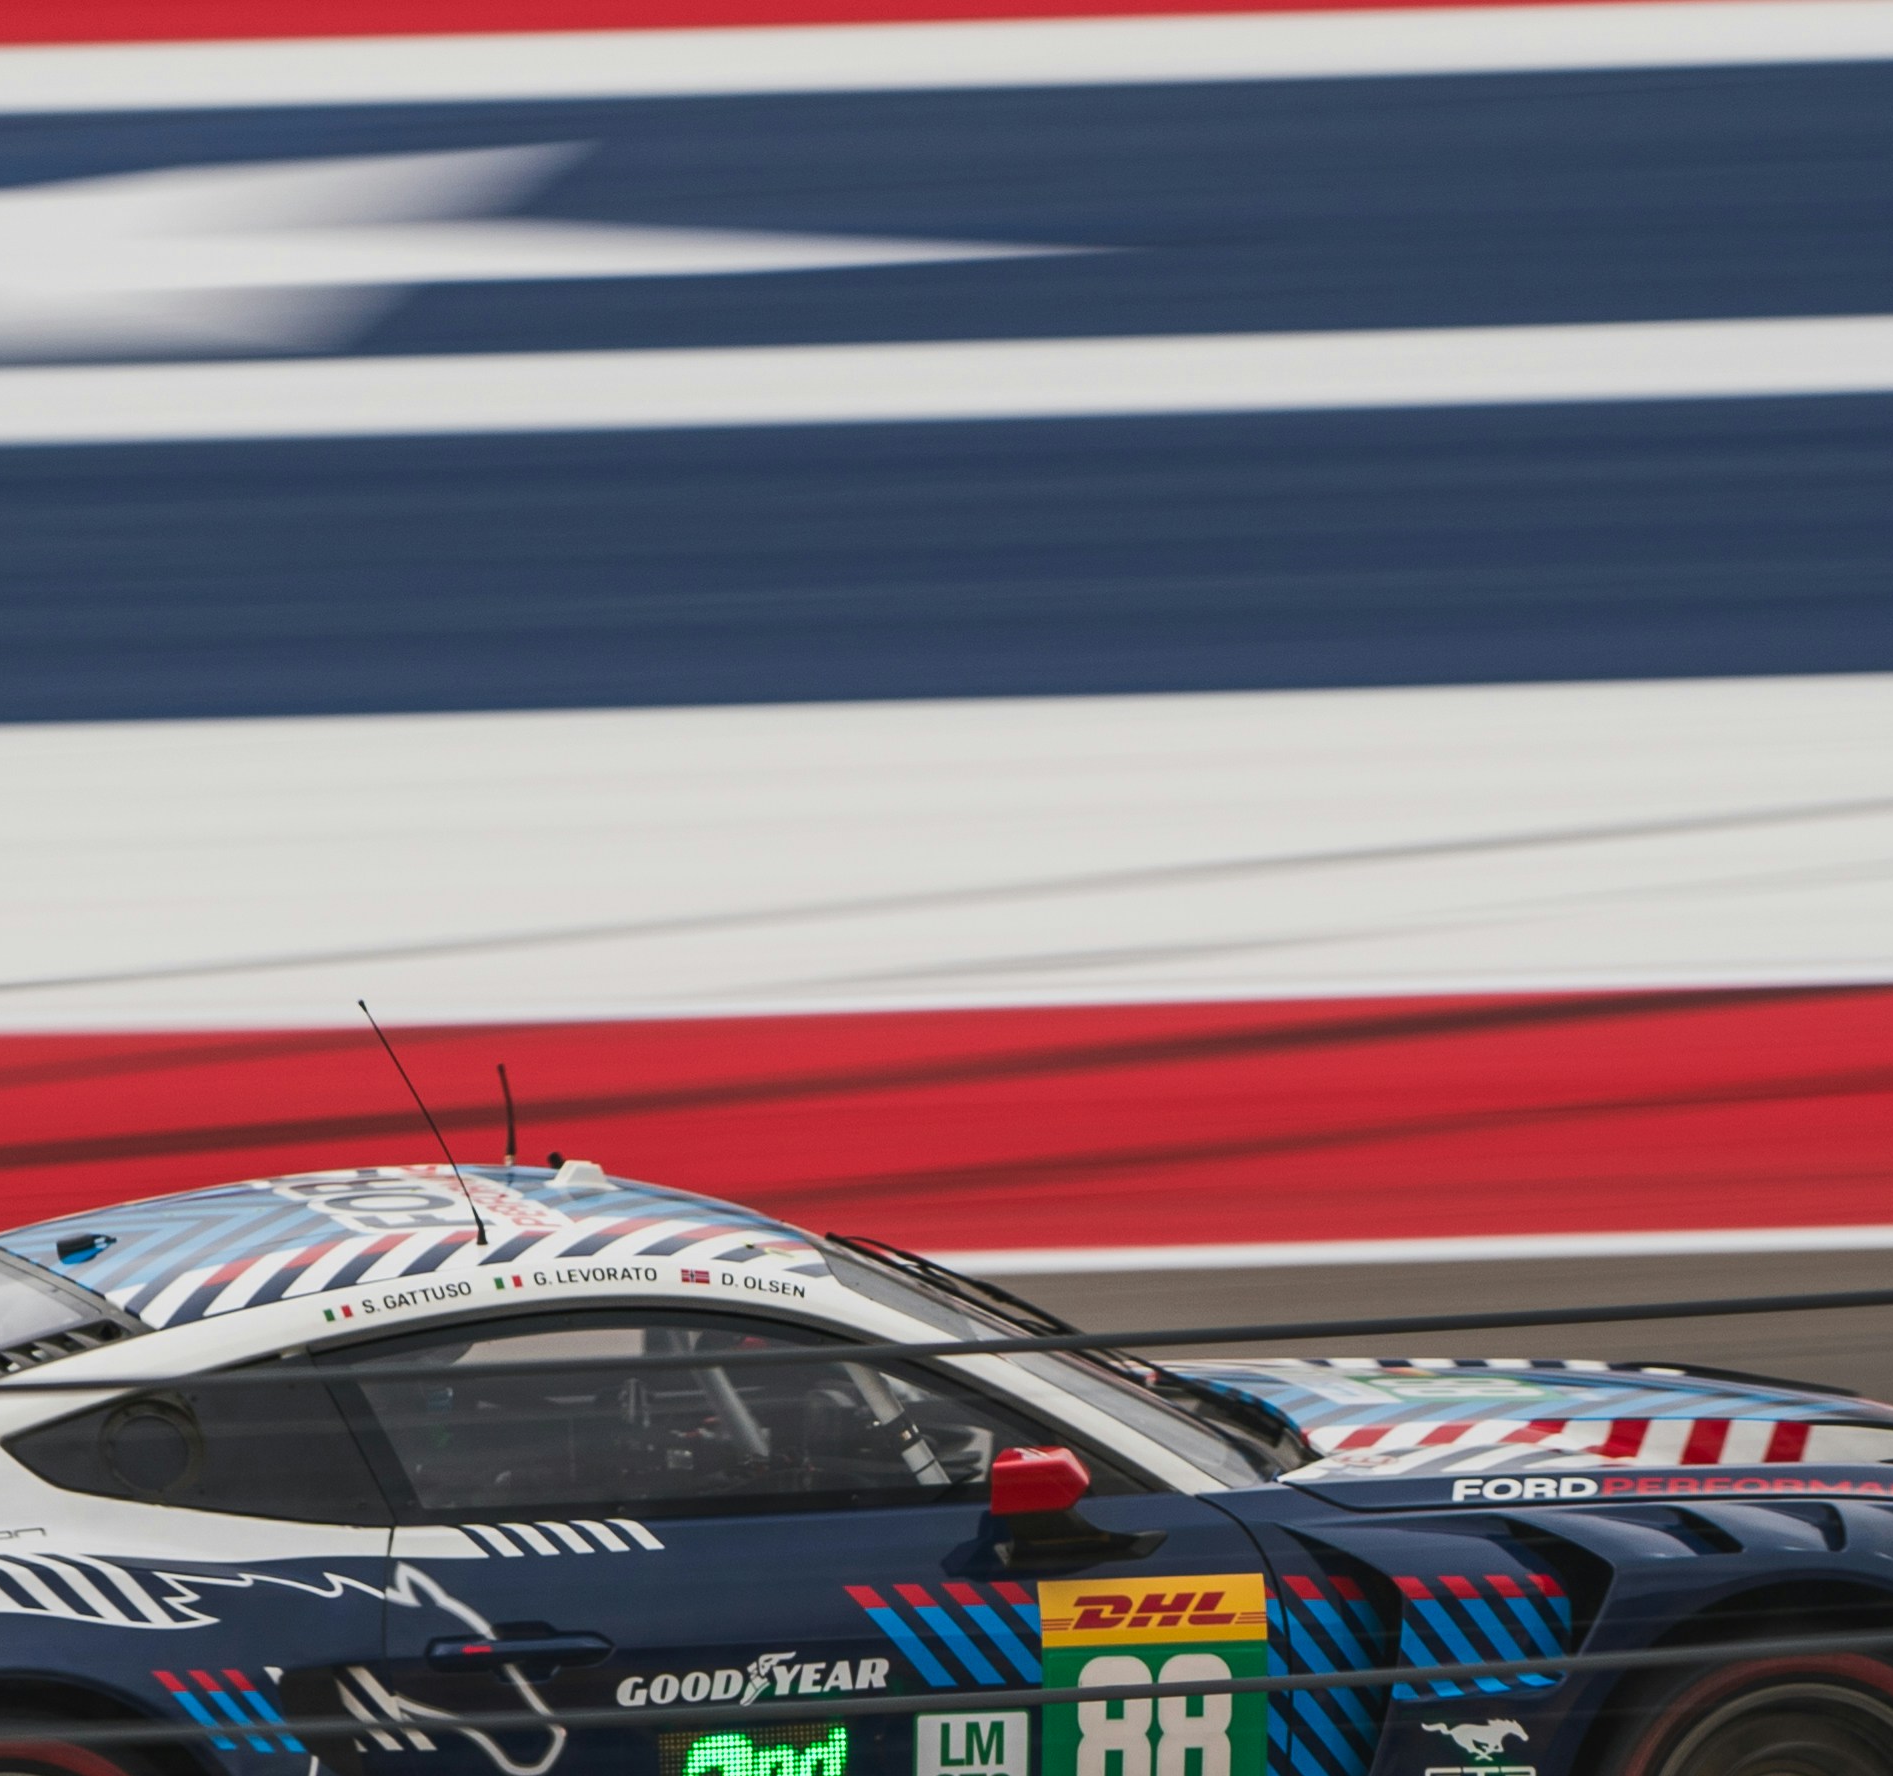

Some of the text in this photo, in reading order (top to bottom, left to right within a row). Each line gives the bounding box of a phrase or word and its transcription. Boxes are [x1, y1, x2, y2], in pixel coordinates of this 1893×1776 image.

[533, 1267, 658, 1287] G. LEVORATO
[721, 1272, 806, 1299] D. OLSEN
[362, 1281, 473, 1315] S. GATTUSO
[1452, 1477, 1599, 1502] FORD
[1072, 1591, 1242, 1630] DHL
[616, 1651, 890, 1707] GOODYEAR
[938, 1720, 1005, 1767] LM
